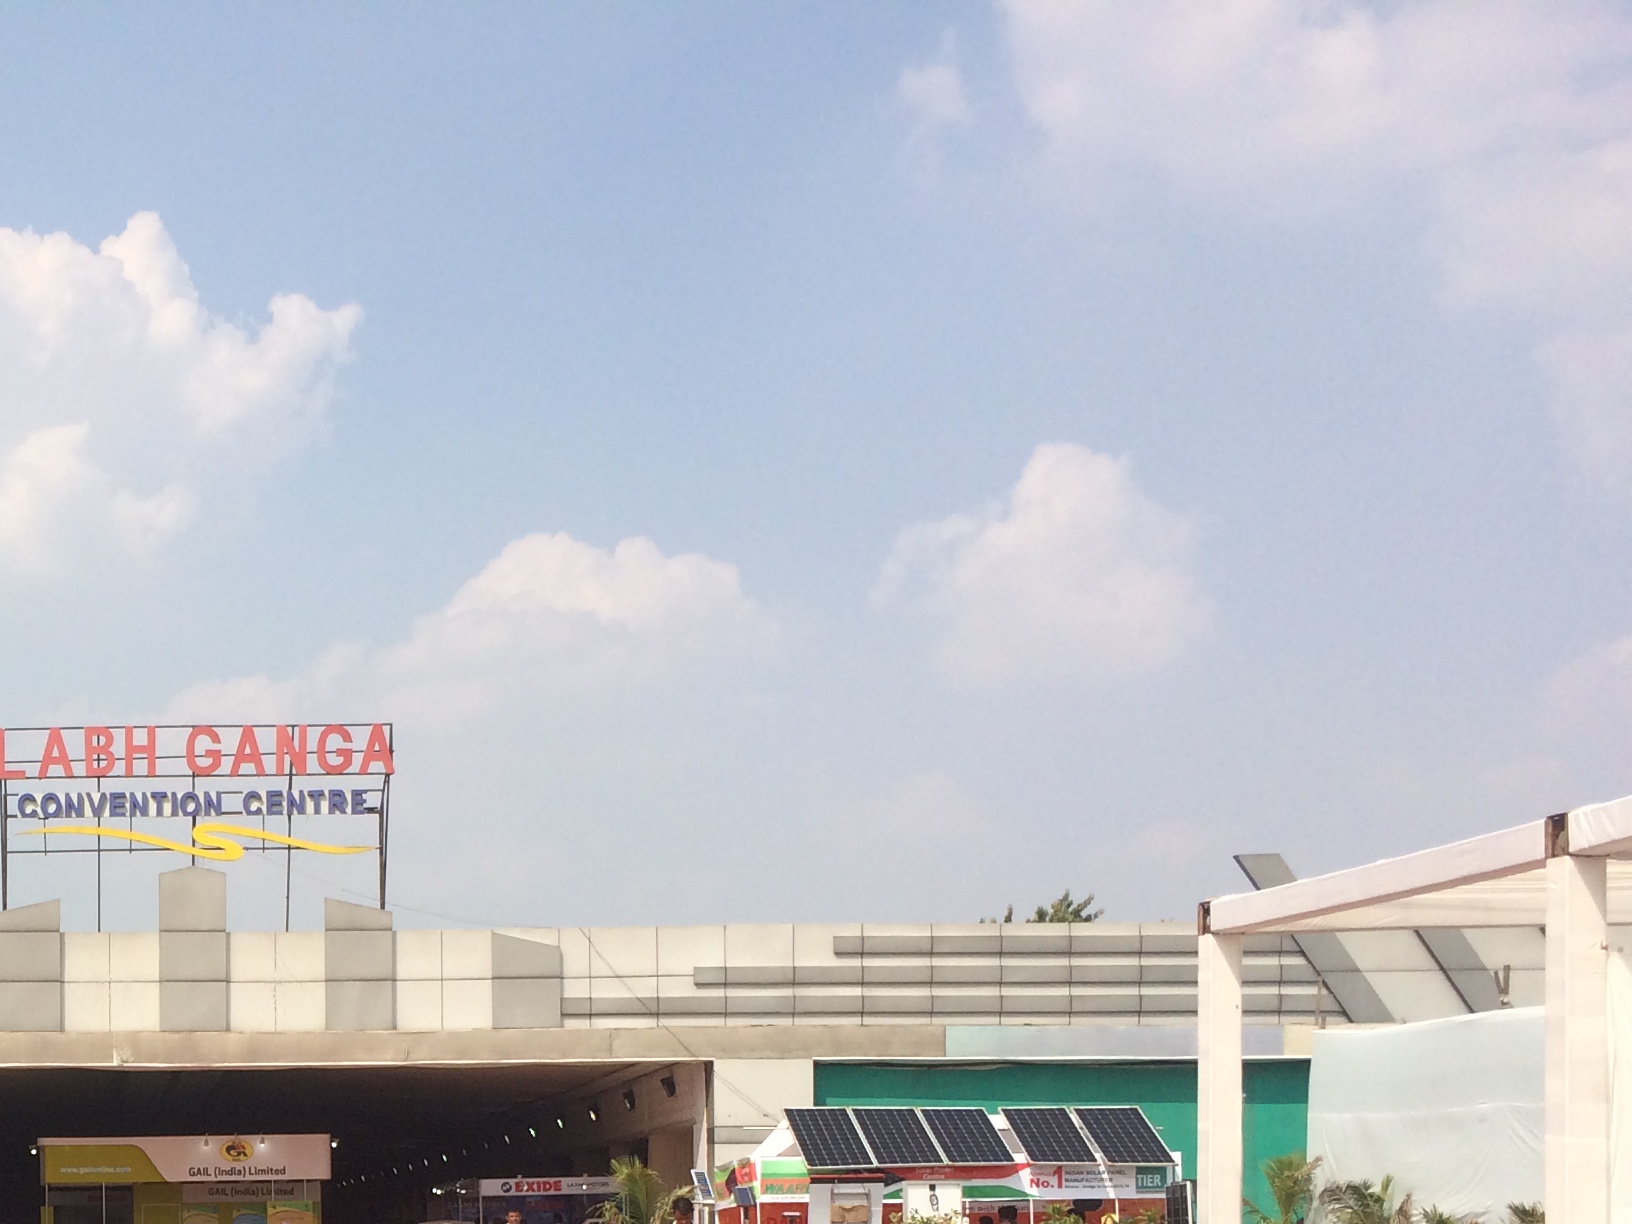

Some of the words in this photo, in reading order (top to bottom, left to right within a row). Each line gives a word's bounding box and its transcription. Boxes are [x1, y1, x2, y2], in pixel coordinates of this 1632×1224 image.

[185, 724, 395, 776] GANGA
[17, 791, 222, 819] CONVENTION
[243, 789, 369, 816] CENTRE
[188, 1167, 212, 1177] GAIL
[214, 1166, 246, 1178] (India)
[248, 1166, 286, 1176] Limited
[514, 1180, 562, 1193] EXIDE
[1137, 1174, 1161, 1187] TIER
[208, 1187, 229, 1196] GAIL
[230, 1186, 259, 1198] (India)
